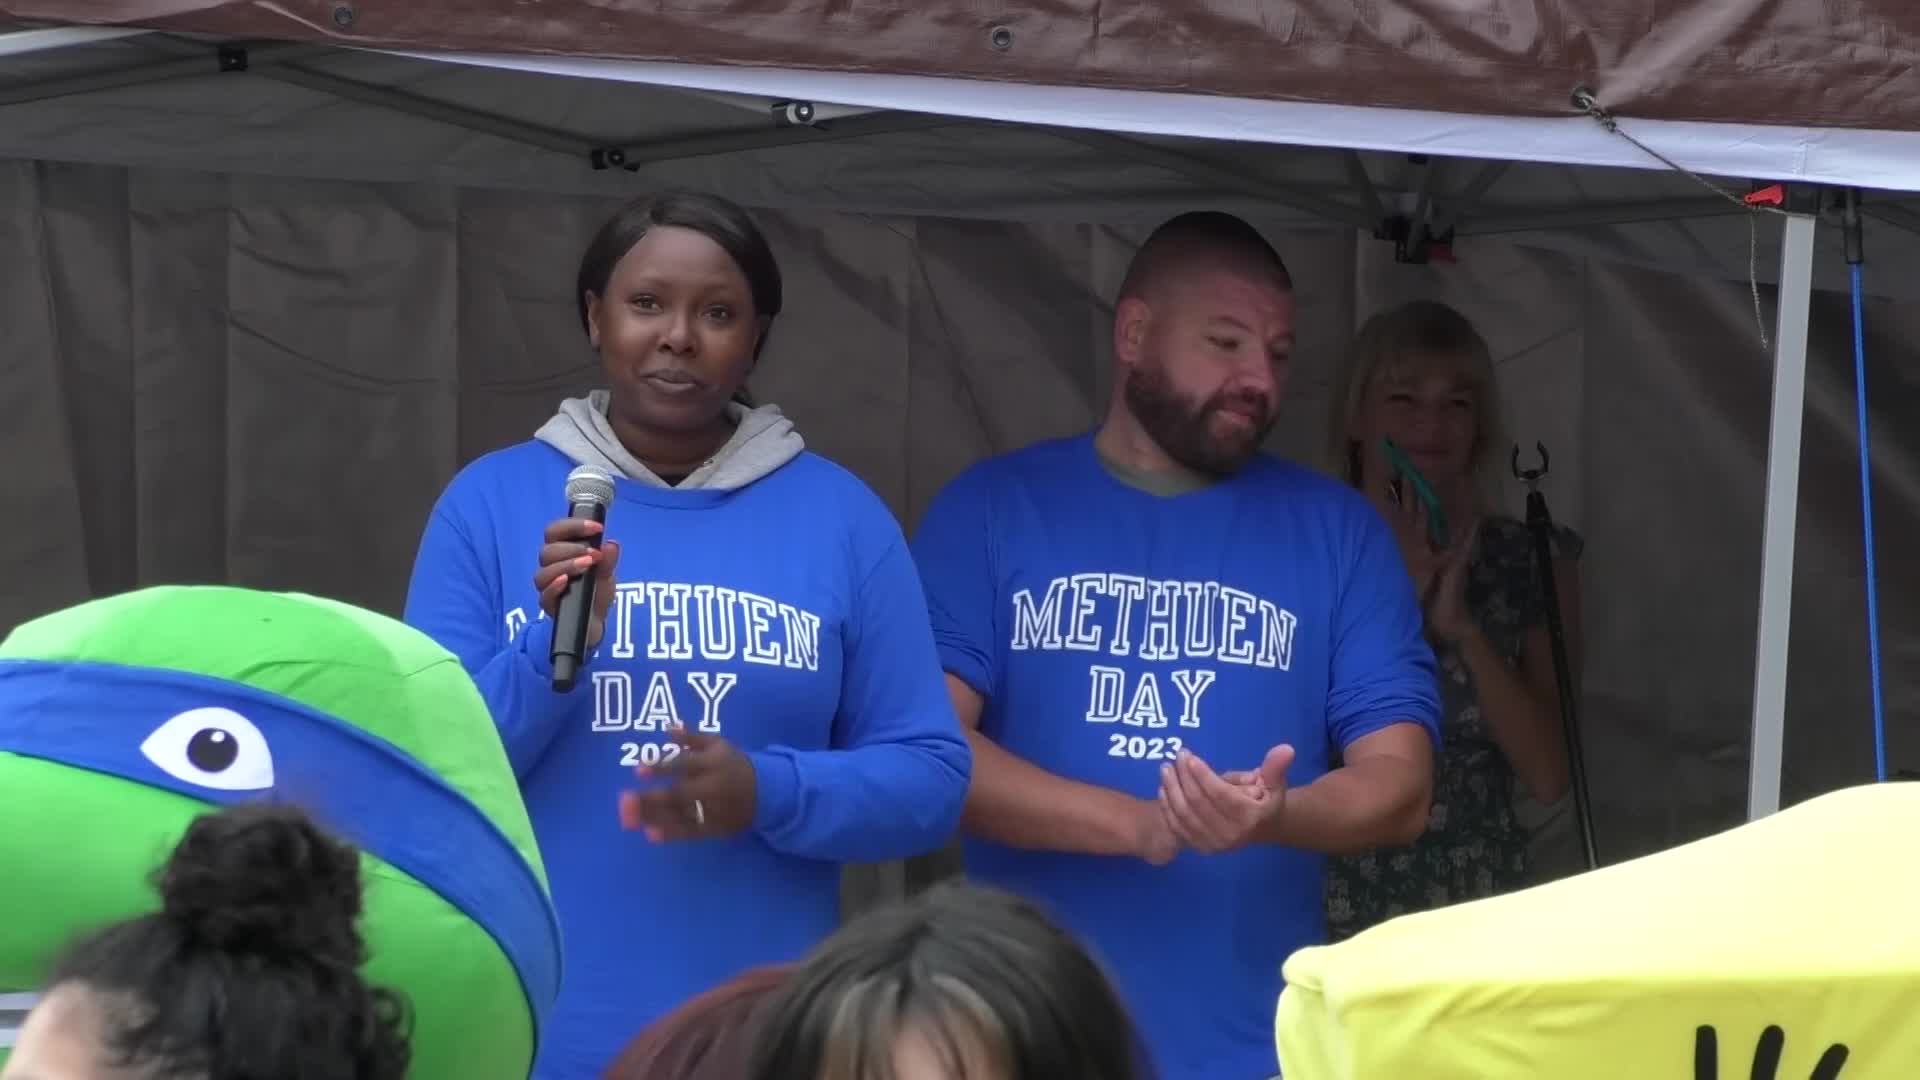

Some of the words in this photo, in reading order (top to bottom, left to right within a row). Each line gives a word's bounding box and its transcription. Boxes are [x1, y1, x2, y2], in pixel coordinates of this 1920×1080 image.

[506, 582, 821, 671] THUEN
[1011, 572, 1297, 671] METHUEN
[592, 671, 737, 732] DAY
[1086, 665, 1216, 728] DAY
[620, 742, 690, 767] 202
[1108, 733, 1182, 760] 2023
